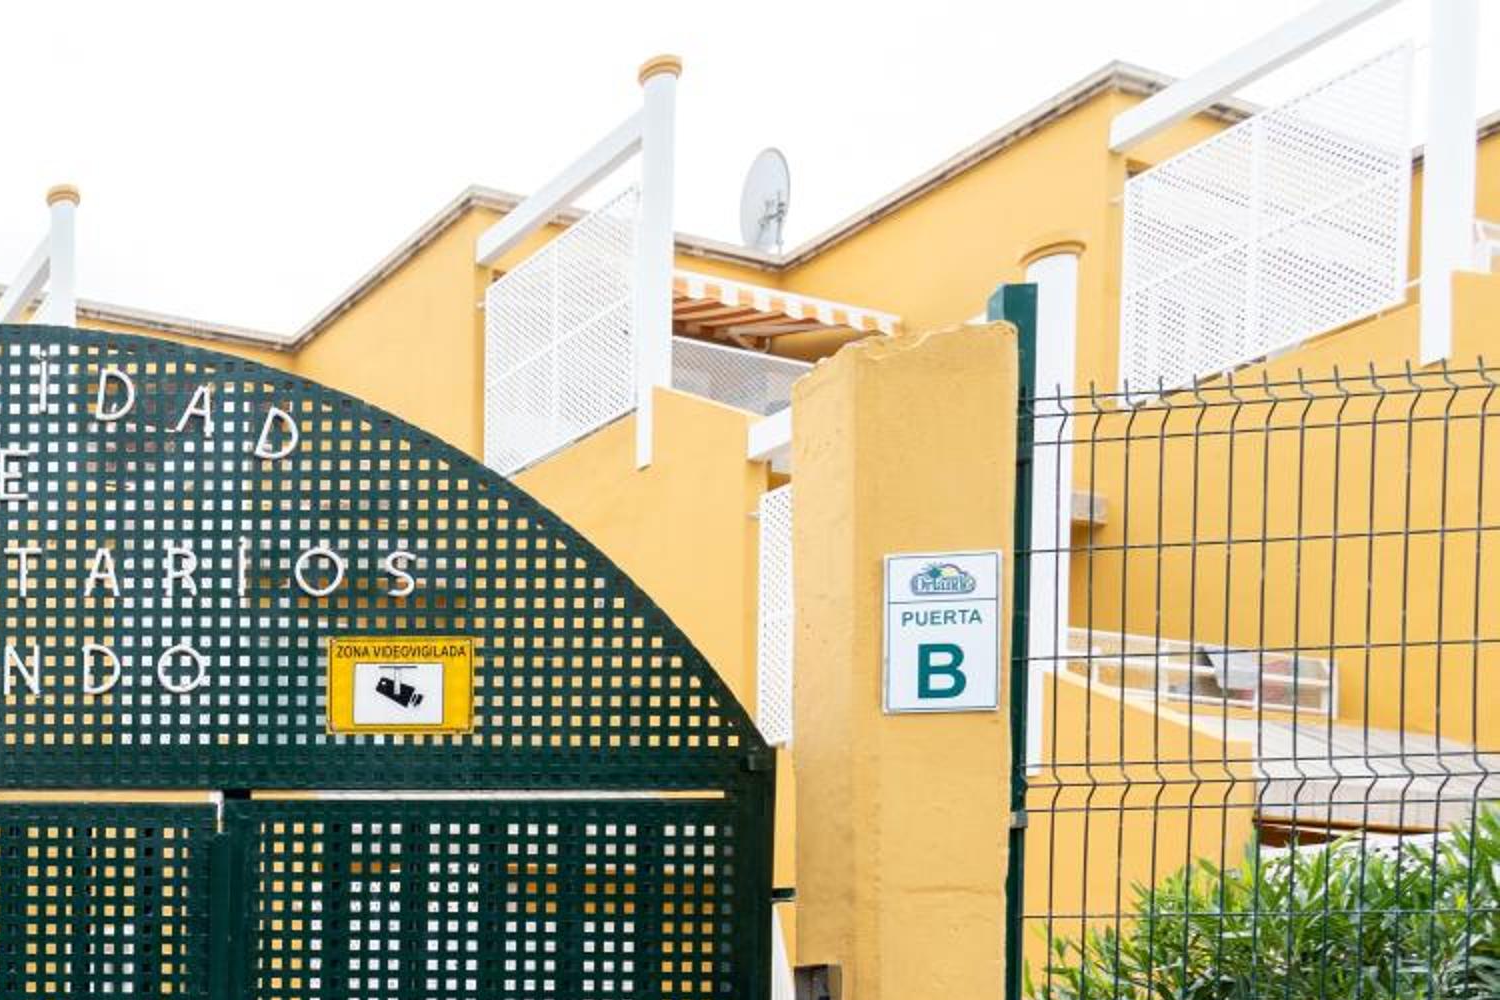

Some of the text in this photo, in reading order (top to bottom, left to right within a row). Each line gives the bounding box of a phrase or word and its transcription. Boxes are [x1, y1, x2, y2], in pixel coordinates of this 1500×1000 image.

[901, 609, 982, 626] PUERTA
[336, 645, 467, 658] ZONA VIDEOVIGILADA
[918, 643, 967, 699] B
